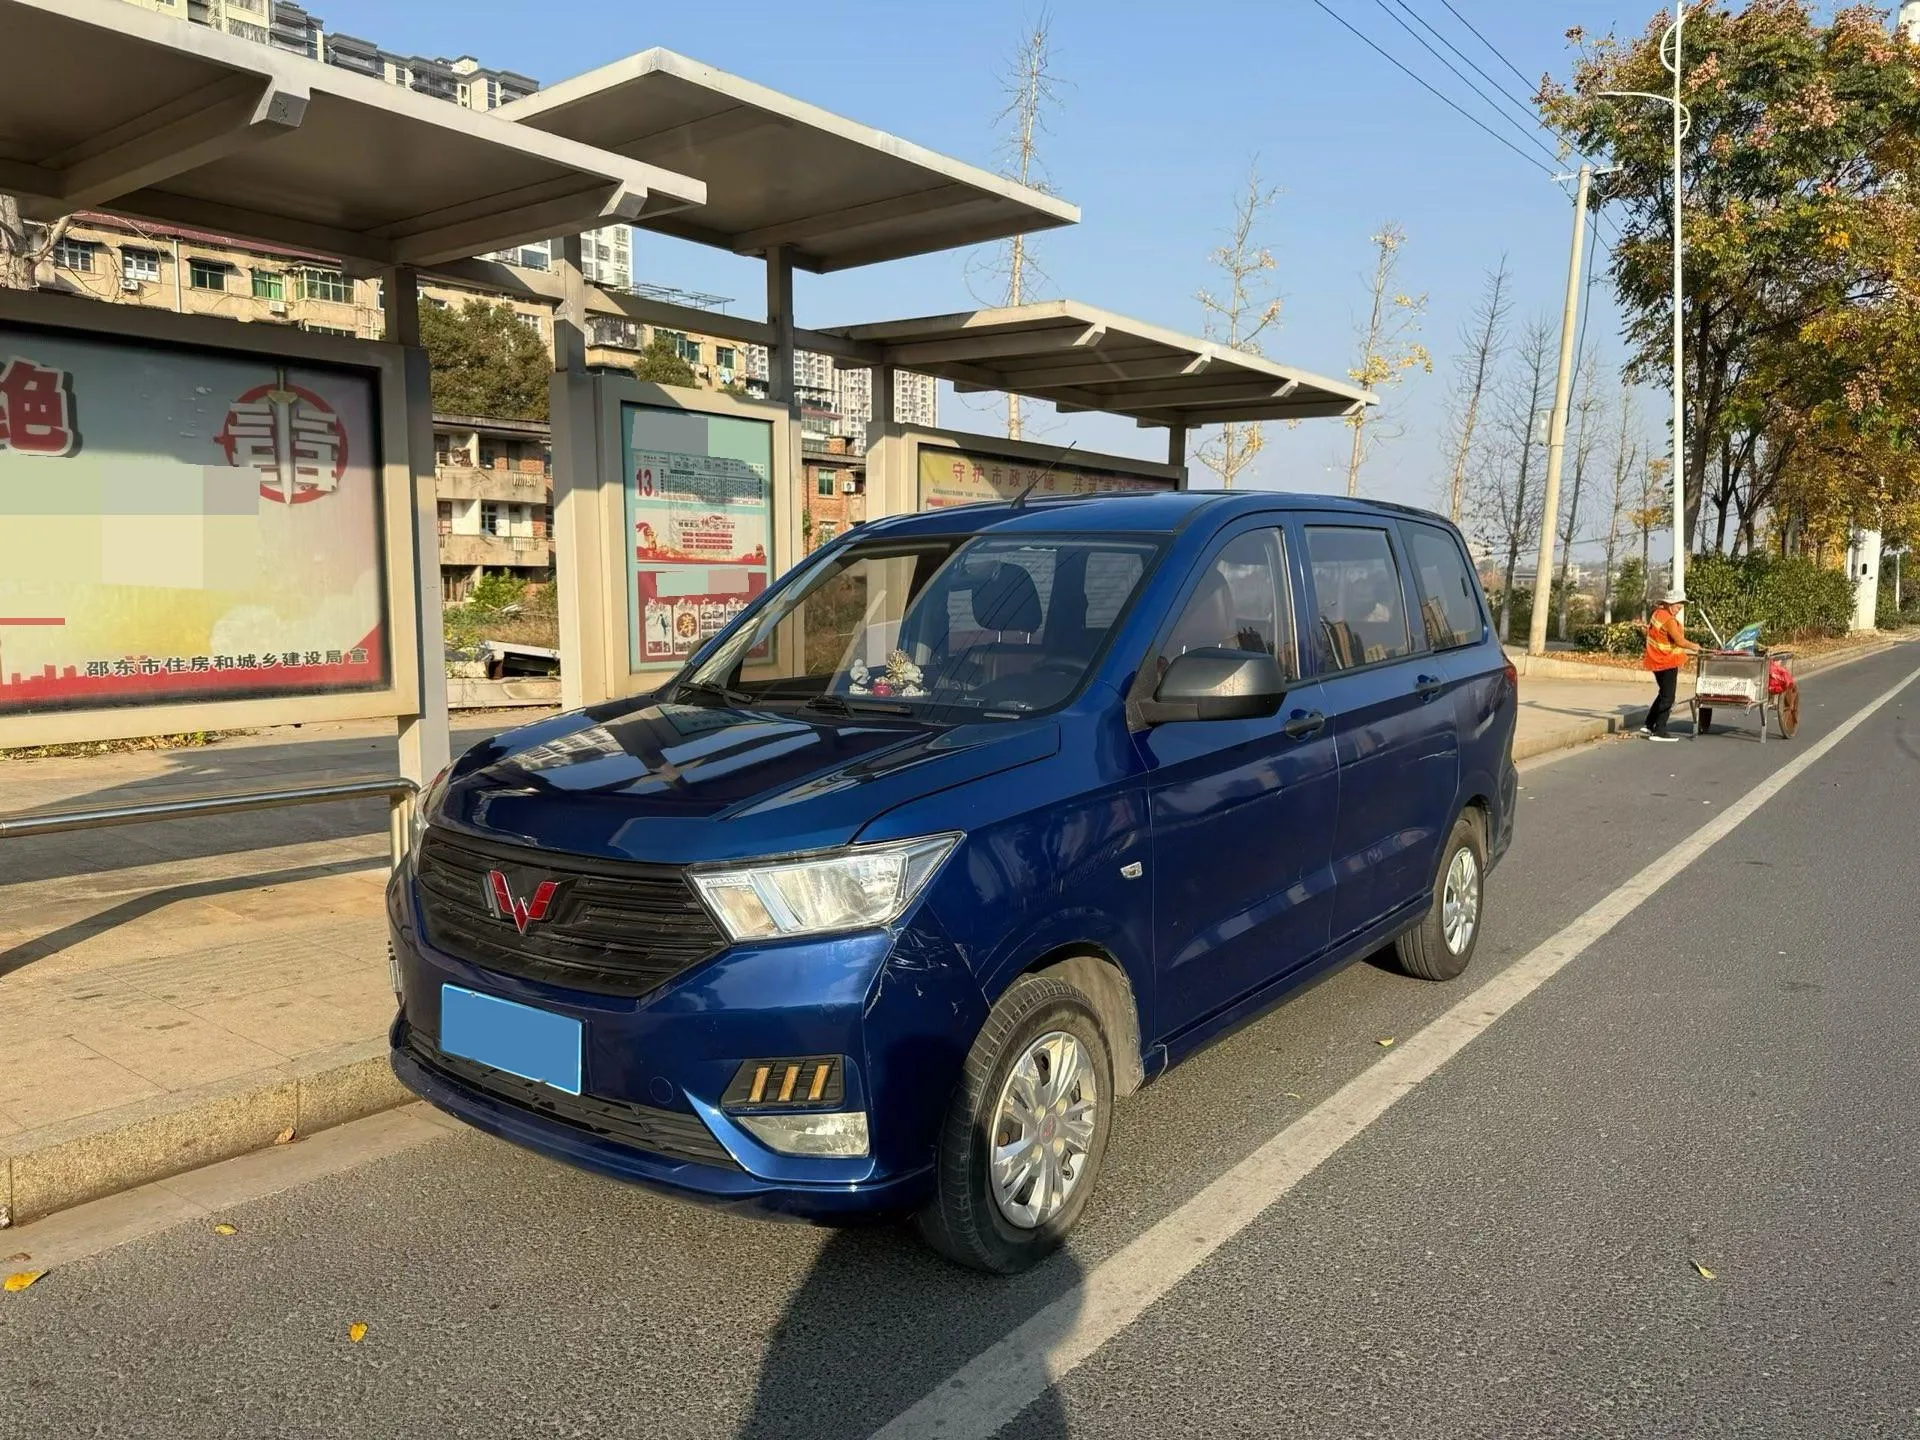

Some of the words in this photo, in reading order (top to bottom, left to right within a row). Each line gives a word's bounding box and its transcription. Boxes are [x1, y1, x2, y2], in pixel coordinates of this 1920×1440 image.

[636, 468, 652, 496] 13
[86, 649, 342, 677] 邵东市住房和城乡建设局
[349, 648, 368, 664] 宣
